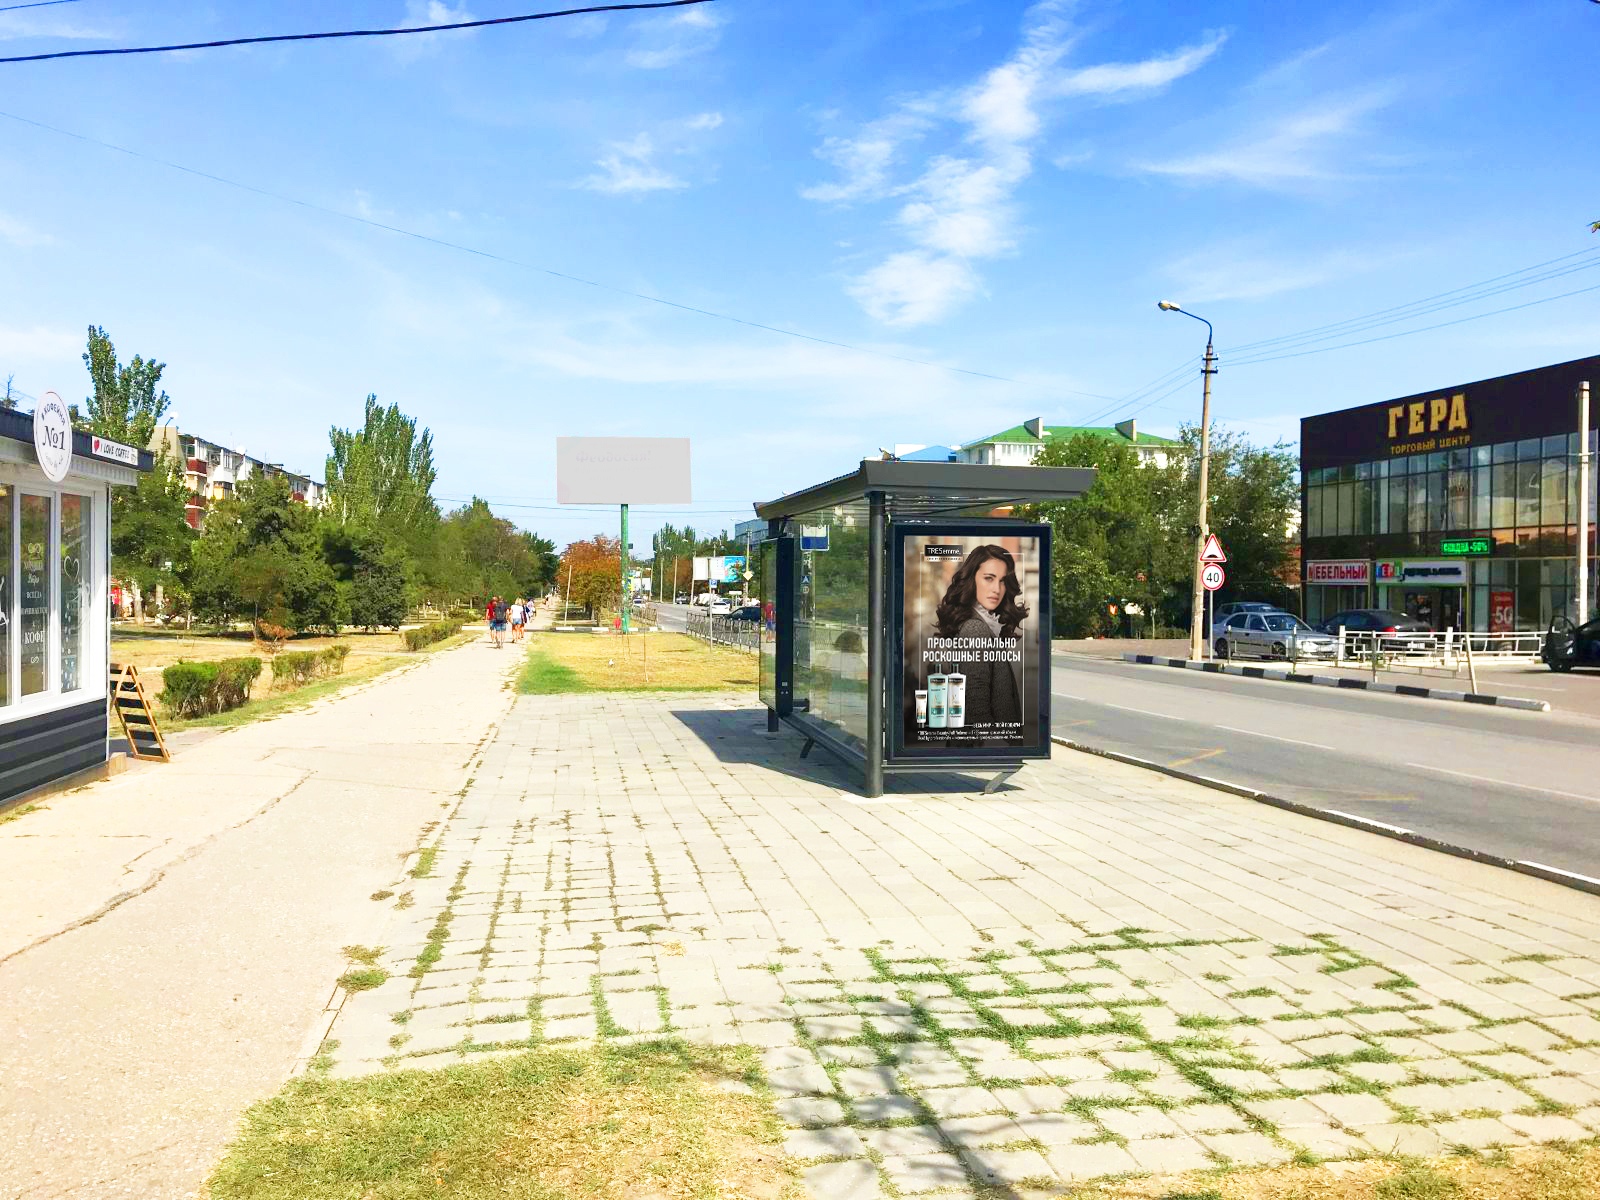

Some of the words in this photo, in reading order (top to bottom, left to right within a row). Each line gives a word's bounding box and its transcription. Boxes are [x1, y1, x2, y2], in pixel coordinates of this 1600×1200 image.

[1388, 394, 1468, 438] ГЕРА
[103, 445, 115, 457] LOVE
[1391, 438, 1436, 455] ТОРГОВЫЙ
[1439, 435, 1471, 449] ЦЕНТР
[1206, 572, 1220, 583] 40
[1308, 562, 1368, 581] МЕБЕЛЬНЫЙ
[927, 637, 1017, 649] ПРОФЕССИОНАЛЬНО
[923, 650, 980, 662] РОСКОШНЫЕ
[983, 650, 1021, 662] ВОЛОСЫ
